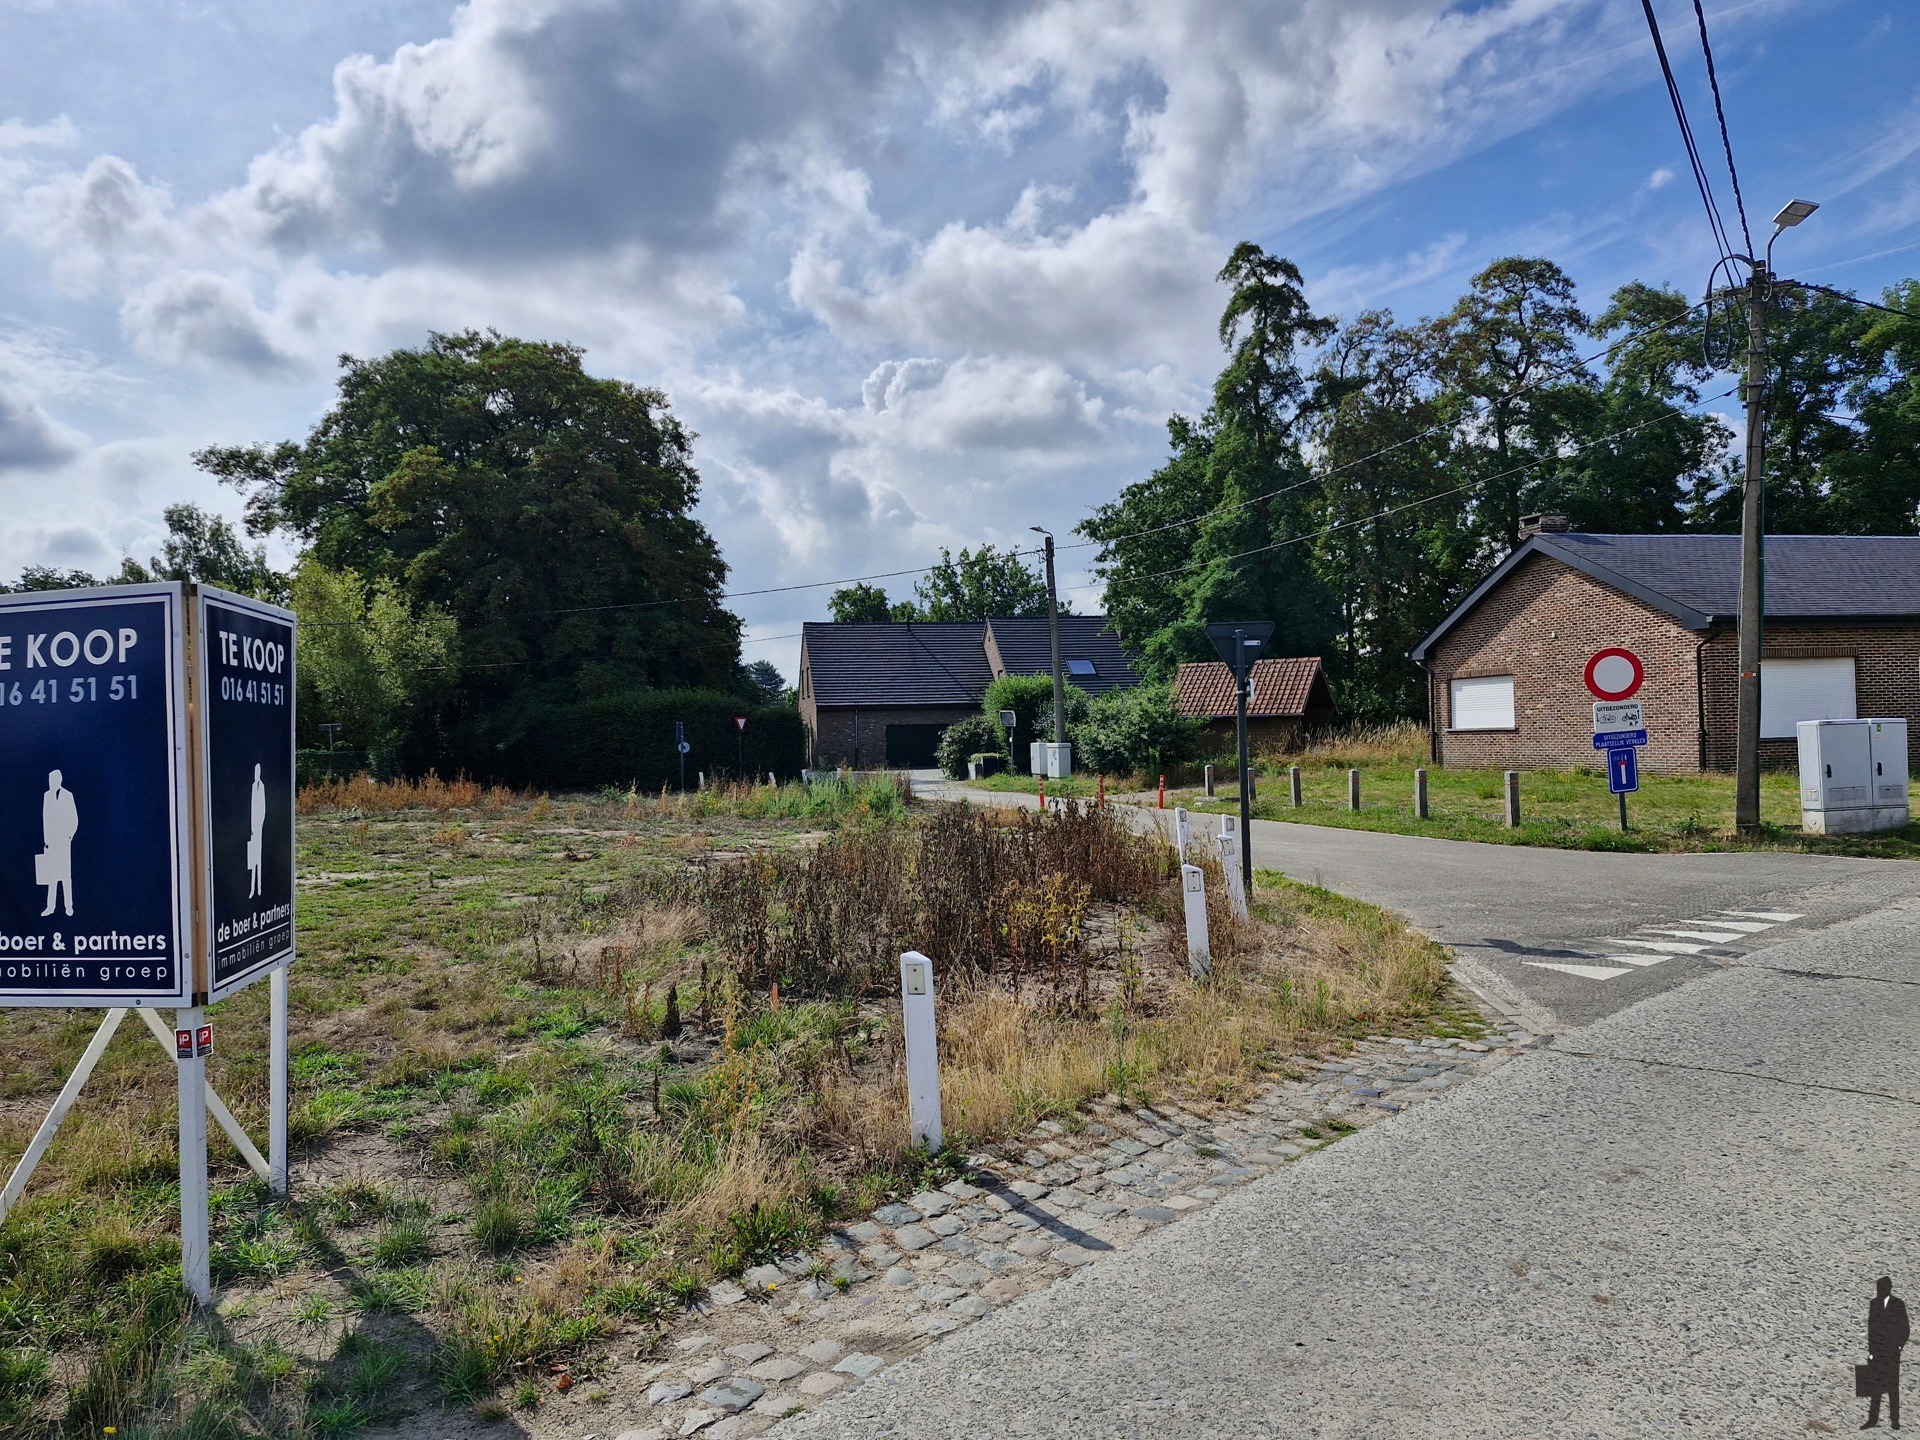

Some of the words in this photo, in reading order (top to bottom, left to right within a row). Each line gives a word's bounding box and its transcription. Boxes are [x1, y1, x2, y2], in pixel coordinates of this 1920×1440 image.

[0, 636, 12, 670] E
[26, 628, 138, 668] KOOP
[219, 630, 238, 667] TE
[242, 635, 285, 674] KOOP
[0, 681, 23, 706] 16
[30, 679, 57, 704] 41
[69, 677, 97, 703] 51
[108, 675, 137, 701] 51
[221, 676, 243, 702] 016
[246, 680, 257, 703] 41
[260, 681, 271, 704] 51
[274, 684, 284, 706] 51
[1596, 704, 1638, 712] UITGEZONDERD
[217, 922, 231, 943] de
[232, 918, 251, 938] boer
[252, 911, 259, 930] &
[260, 903, 290, 930] partners
[0, 931, 45, 951] boer
[52, 932, 66, 951] &
[74, 930, 167, 955] partners
[217, 940, 265, 971] immobiliën
[268, 929, 290, 951] groep
[0, 963, 85, 978] obiliën
[99, 966, 168, 982] groep
